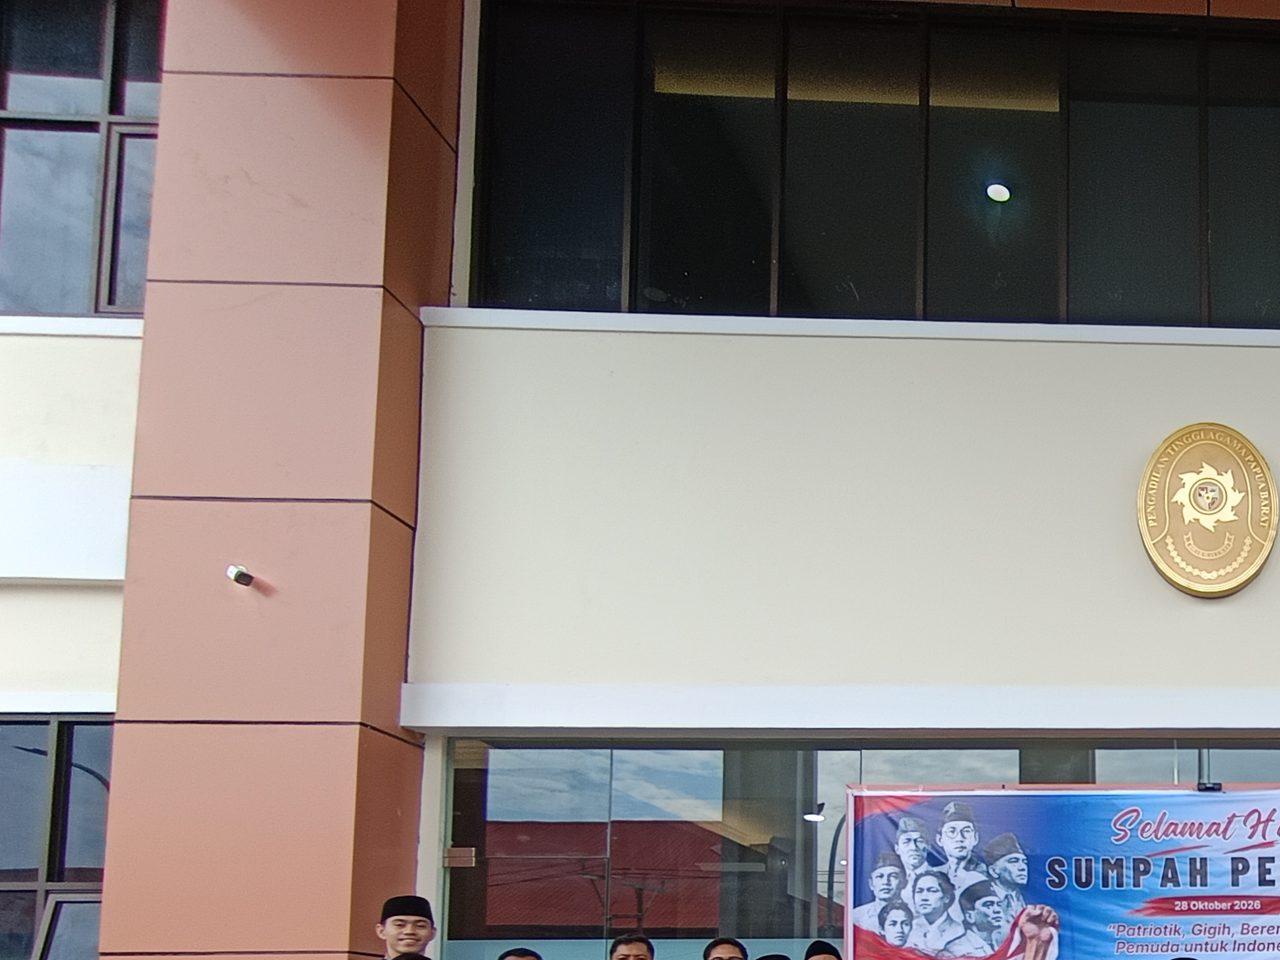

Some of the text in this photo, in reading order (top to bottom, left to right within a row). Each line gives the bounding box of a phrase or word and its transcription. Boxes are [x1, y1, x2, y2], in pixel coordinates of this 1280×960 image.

[1146, 431, 1271, 528] PENGADILAN TINGGI AGAMA PAPUA BARAT
[1112, 808, 1240, 842] Selamat
[1047, 856, 1208, 889] SUMPAH
[1174, 900, 1189, 911] 28
[1190, 900, 1232, 910] Oktober
[1191, 923, 1235, 939] Gigih,
[1115, 941, 1180, 954] Pemuda
[1184, 940, 1228, 953] untuk
